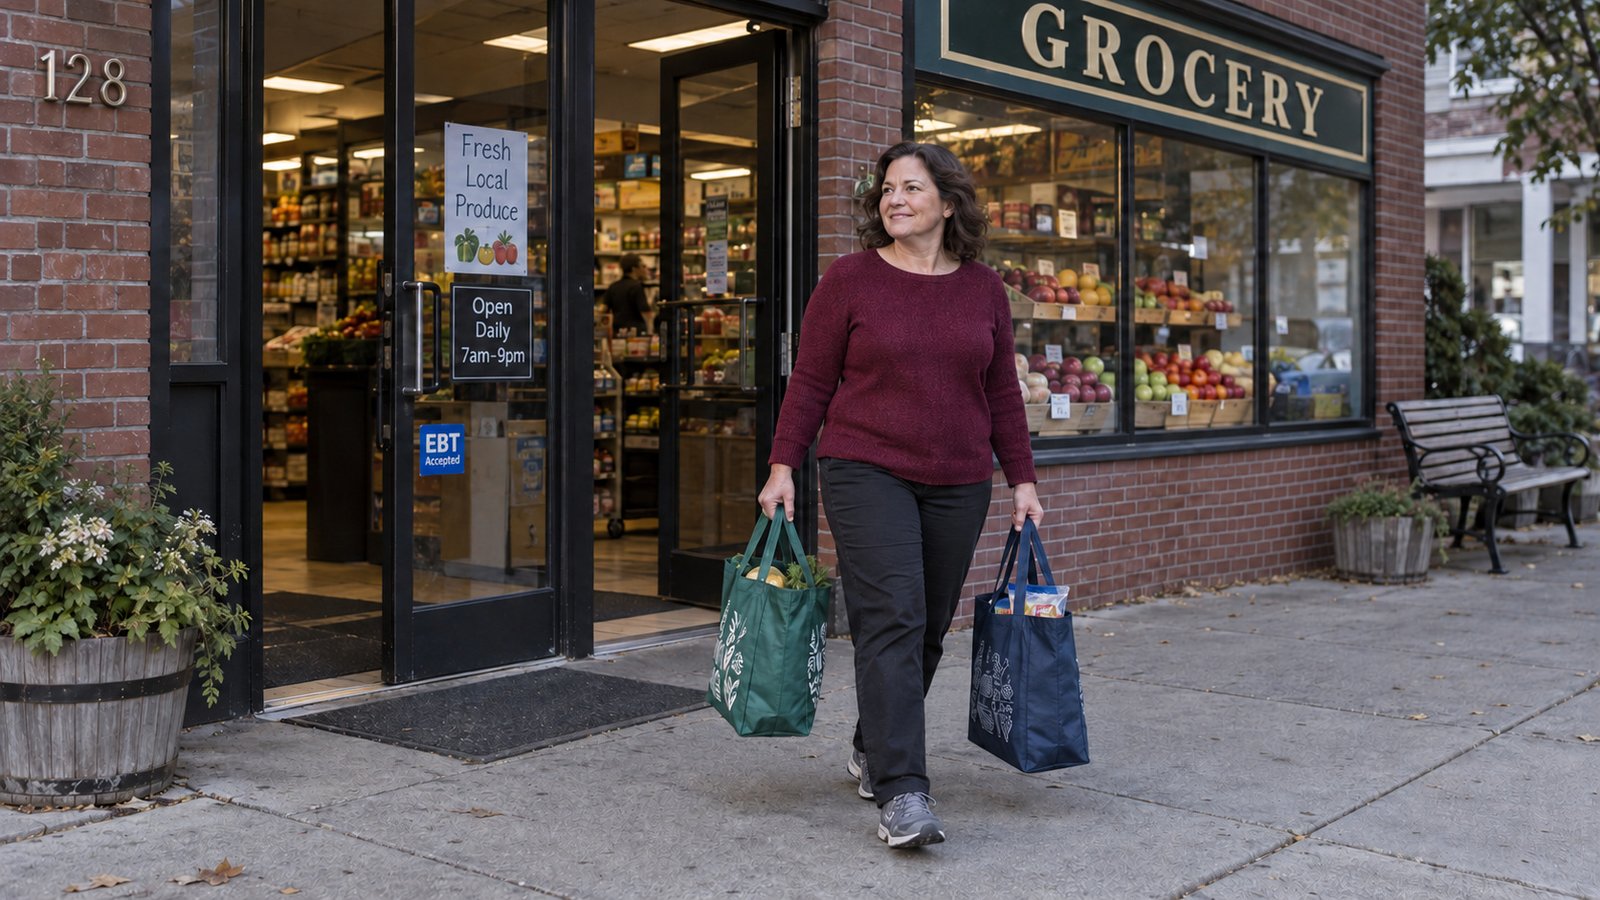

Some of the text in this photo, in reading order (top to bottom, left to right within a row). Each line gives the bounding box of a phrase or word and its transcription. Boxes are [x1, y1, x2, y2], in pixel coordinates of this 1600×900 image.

[40, 50, 128, 107] 128
[1021, 3, 1324, 138] GROCERY
[462, 133, 511, 161] Fresh
[466, 164, 508, 190] Local
[456, 194, 518, 221] Produce
[472, 296, 513, 319] Open
[475, 321, 511, 343] Daily
[461, 346, 525, 367] 7am-9pm
[425, 432, 461, 454] EBT
[425, 454, 461, 467] Accepted
